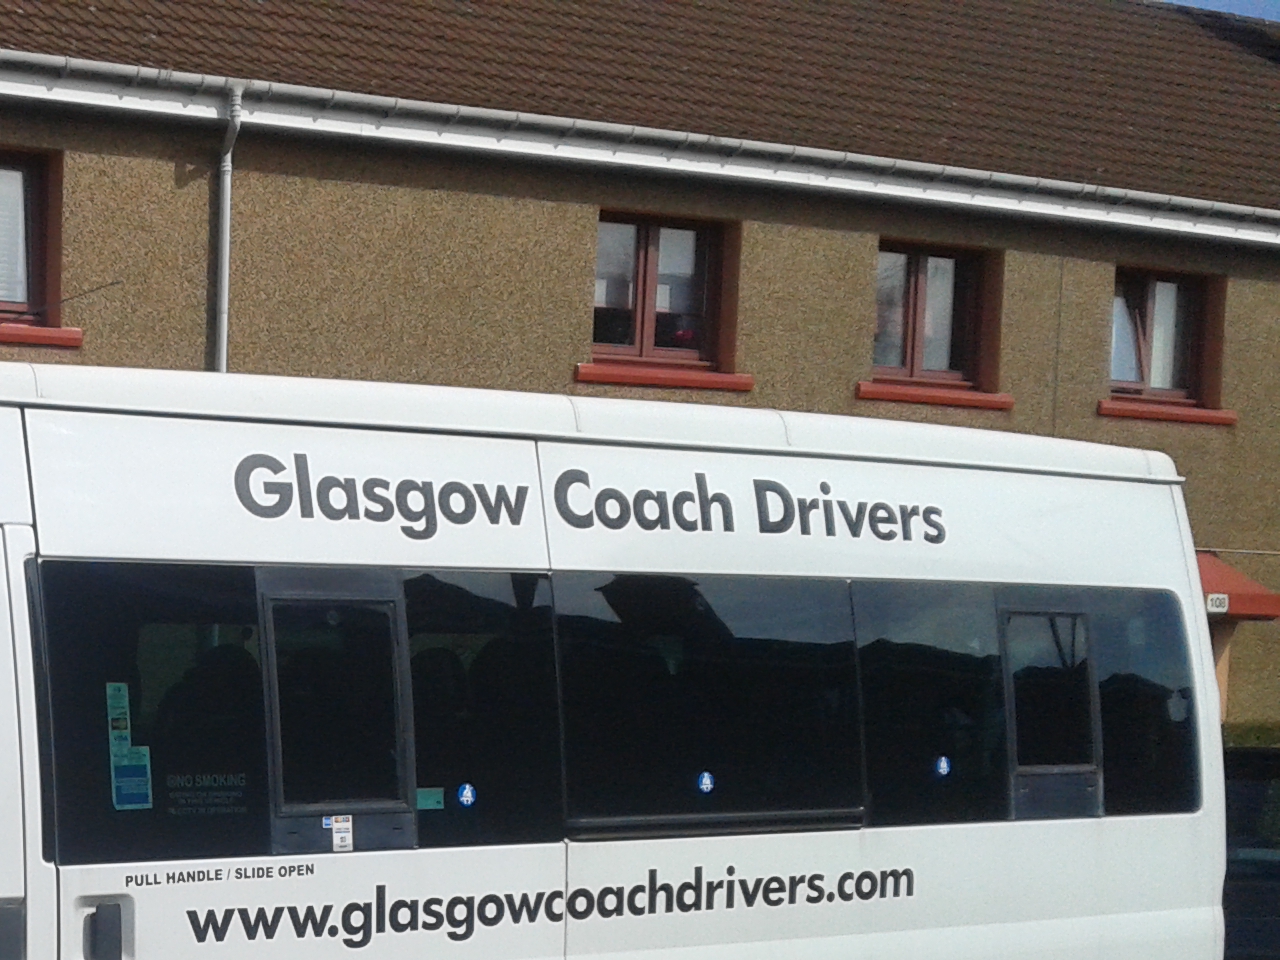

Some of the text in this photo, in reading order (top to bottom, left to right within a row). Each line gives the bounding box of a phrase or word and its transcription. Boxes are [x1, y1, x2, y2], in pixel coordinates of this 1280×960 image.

[235, 453, 948, 545] Glasgow Coach Drivers
[125, 873, 162, 887] PULL
[166, 869, 223, 884] HANDLE
[234, 867, 274, 879] SLIDE
[278, 864, 315, 877] OPEN
[186, 865, 915, 950] www.glasgowcoachdrivers.com
